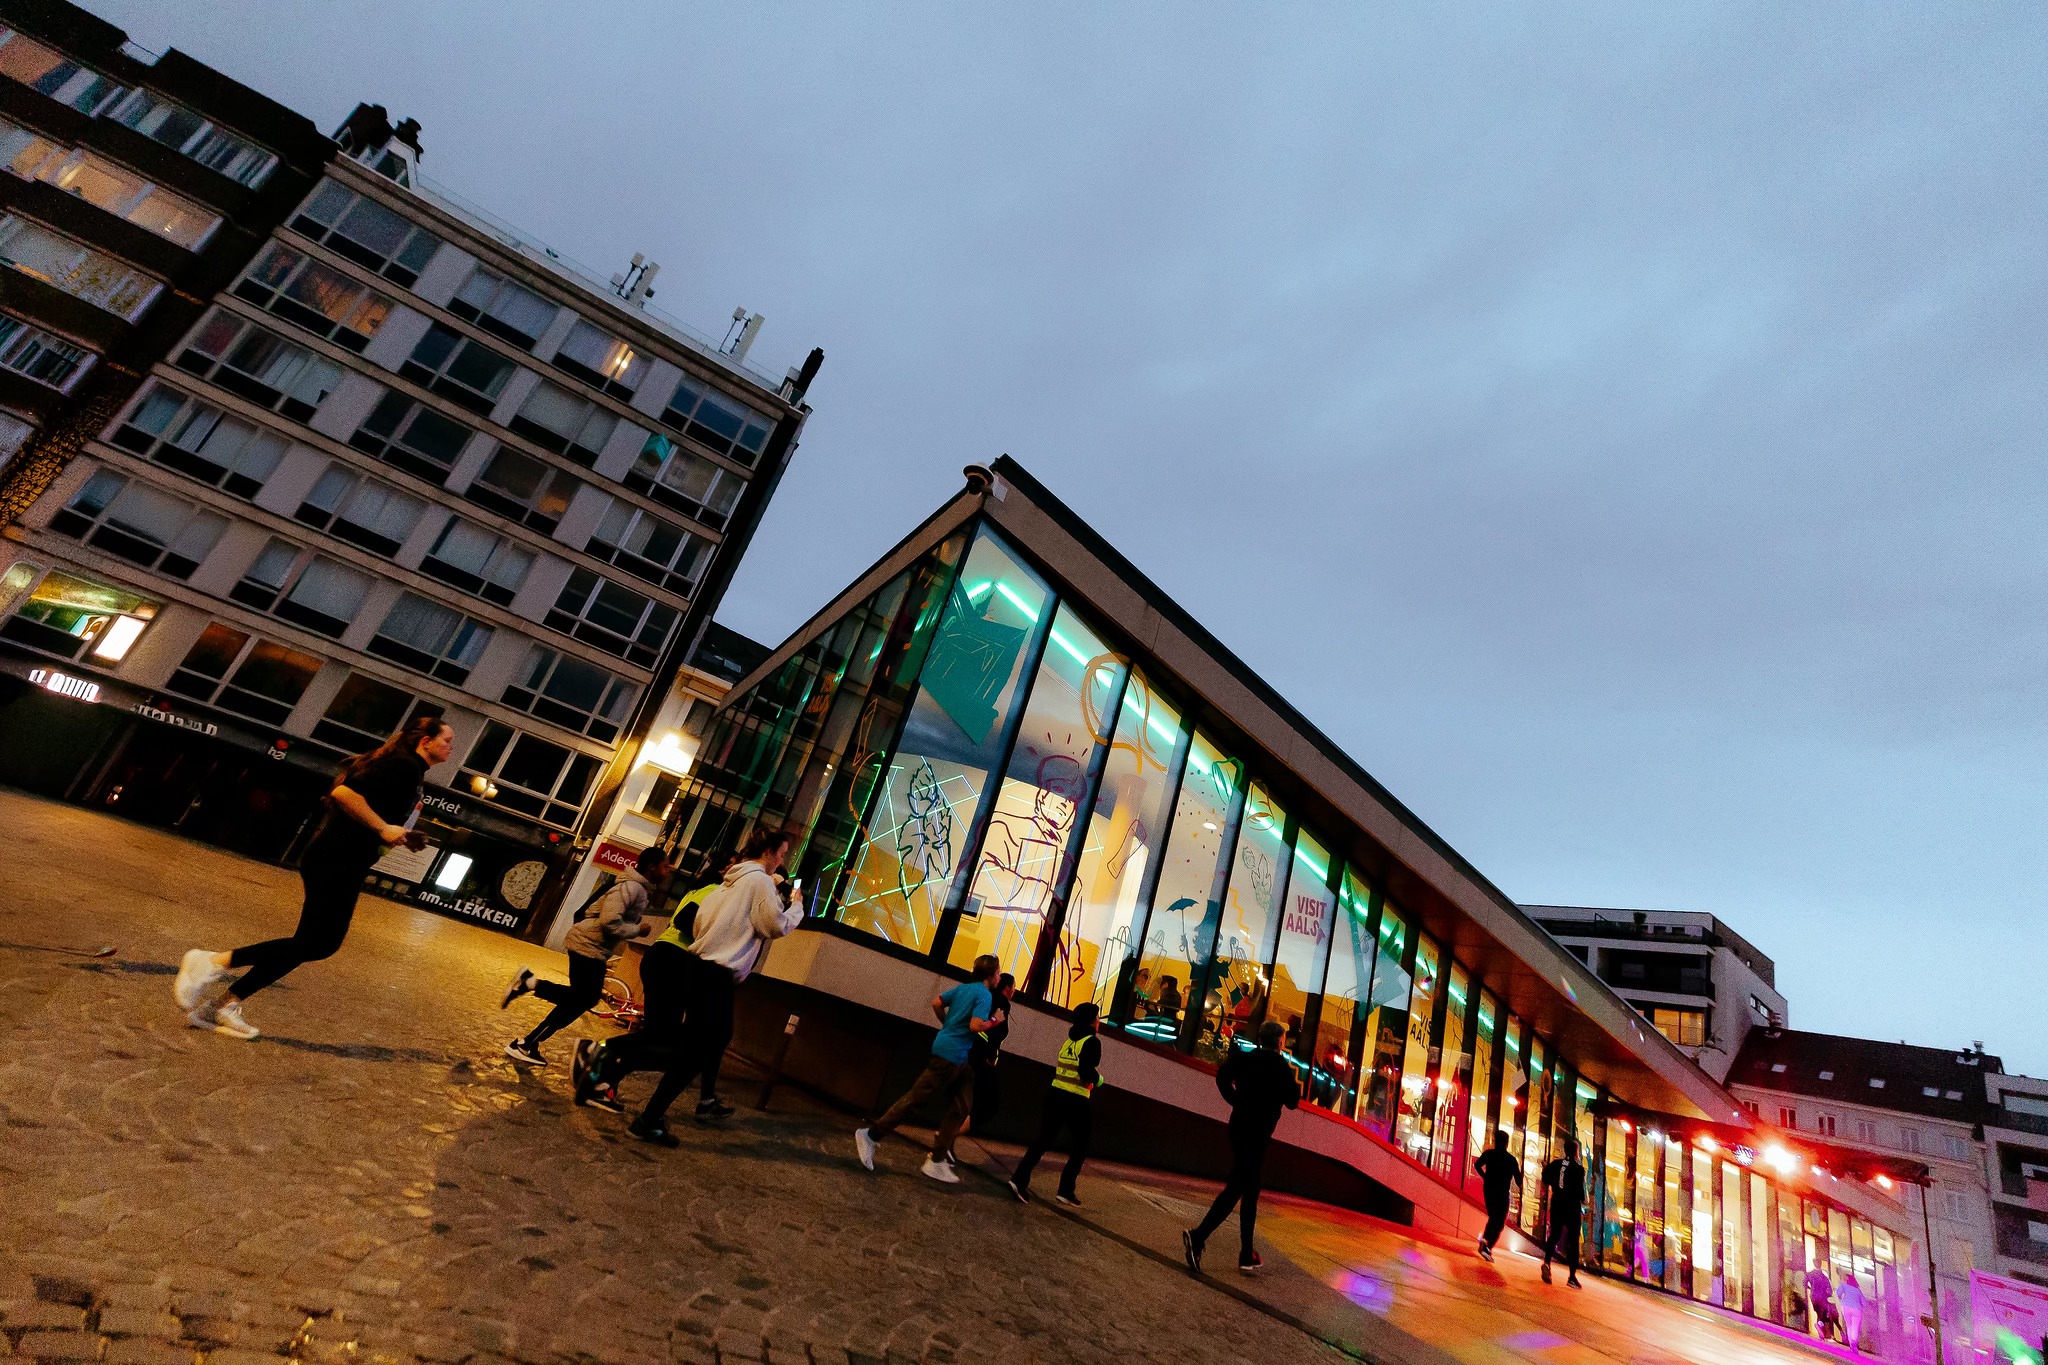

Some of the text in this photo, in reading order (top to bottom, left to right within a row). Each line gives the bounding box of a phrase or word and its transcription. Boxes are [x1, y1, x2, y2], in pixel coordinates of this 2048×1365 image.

[422, 794, 462, 815] arket
[601, 849, 639, 869] Adecc
[1297, 894, 1328, 920] VISIT
[1285, 912, 1326, 946] AALST
